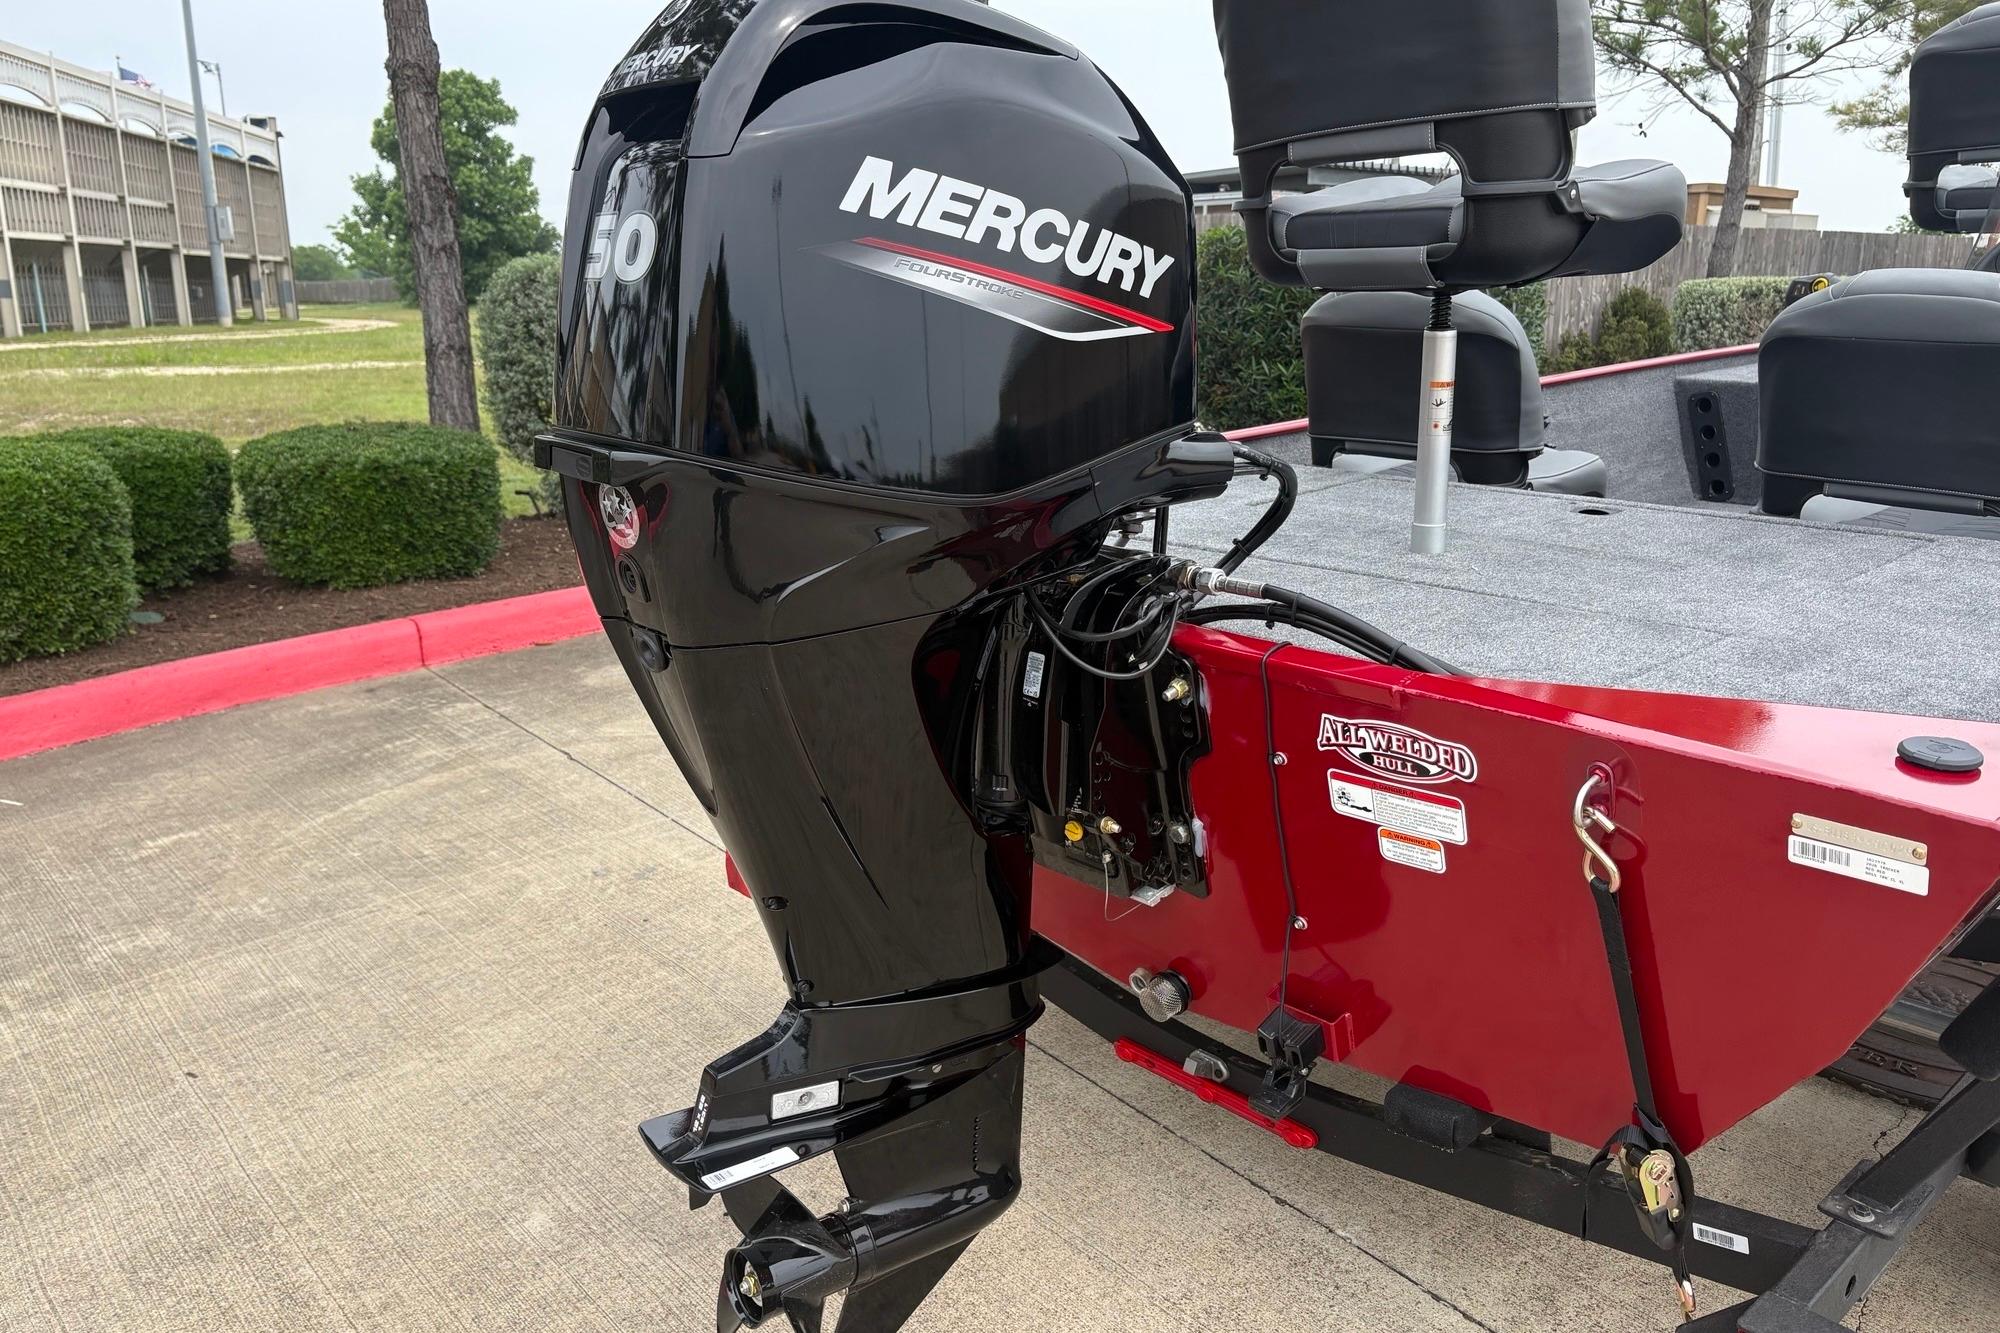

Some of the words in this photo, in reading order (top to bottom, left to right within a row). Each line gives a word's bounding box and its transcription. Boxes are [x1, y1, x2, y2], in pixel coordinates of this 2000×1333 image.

[622, 44, 702, 73] MERCURY
[839, 155, 1175, 299] MERCURY
[585, 210, 658, 284] 50
[894, 257, 1025, 300] FOURSTROKE
[1320, 717, 1365, 747] ALL
[1367, 728, 1473, 778] WELDED
[1372, 754, 1417, 775] HULL
[1379, 784, 1408, 795] DANGER
[1394, 833, 1425, 846] WARNING
